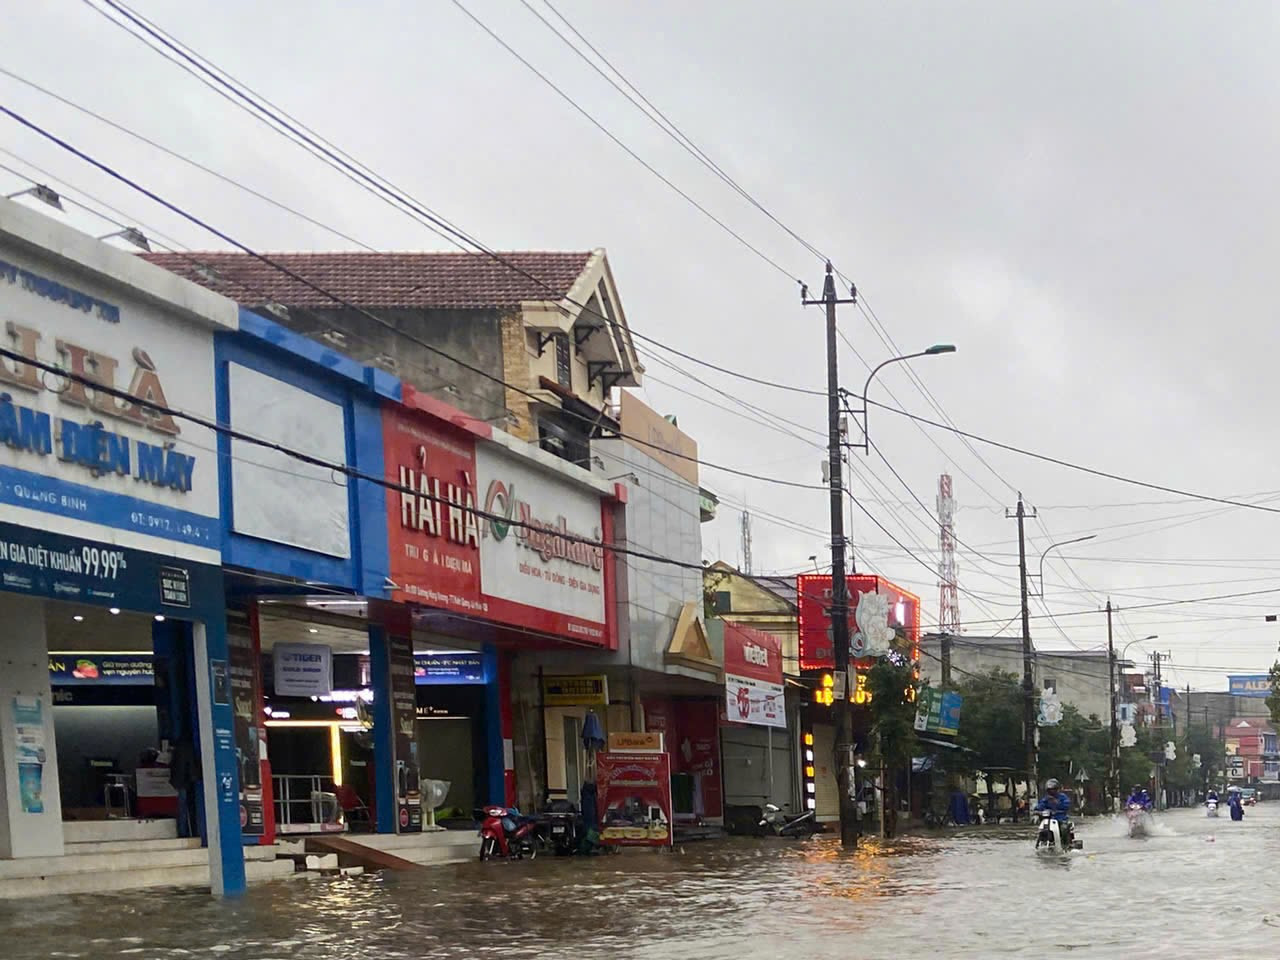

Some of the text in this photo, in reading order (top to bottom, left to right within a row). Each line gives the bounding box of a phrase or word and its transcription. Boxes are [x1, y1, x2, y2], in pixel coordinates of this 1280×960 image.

[400, 445, 480, 548] HẢI HÀ
[10, 543, 27, 563] GIA
[27, 544, 49, 570] DIỆT
